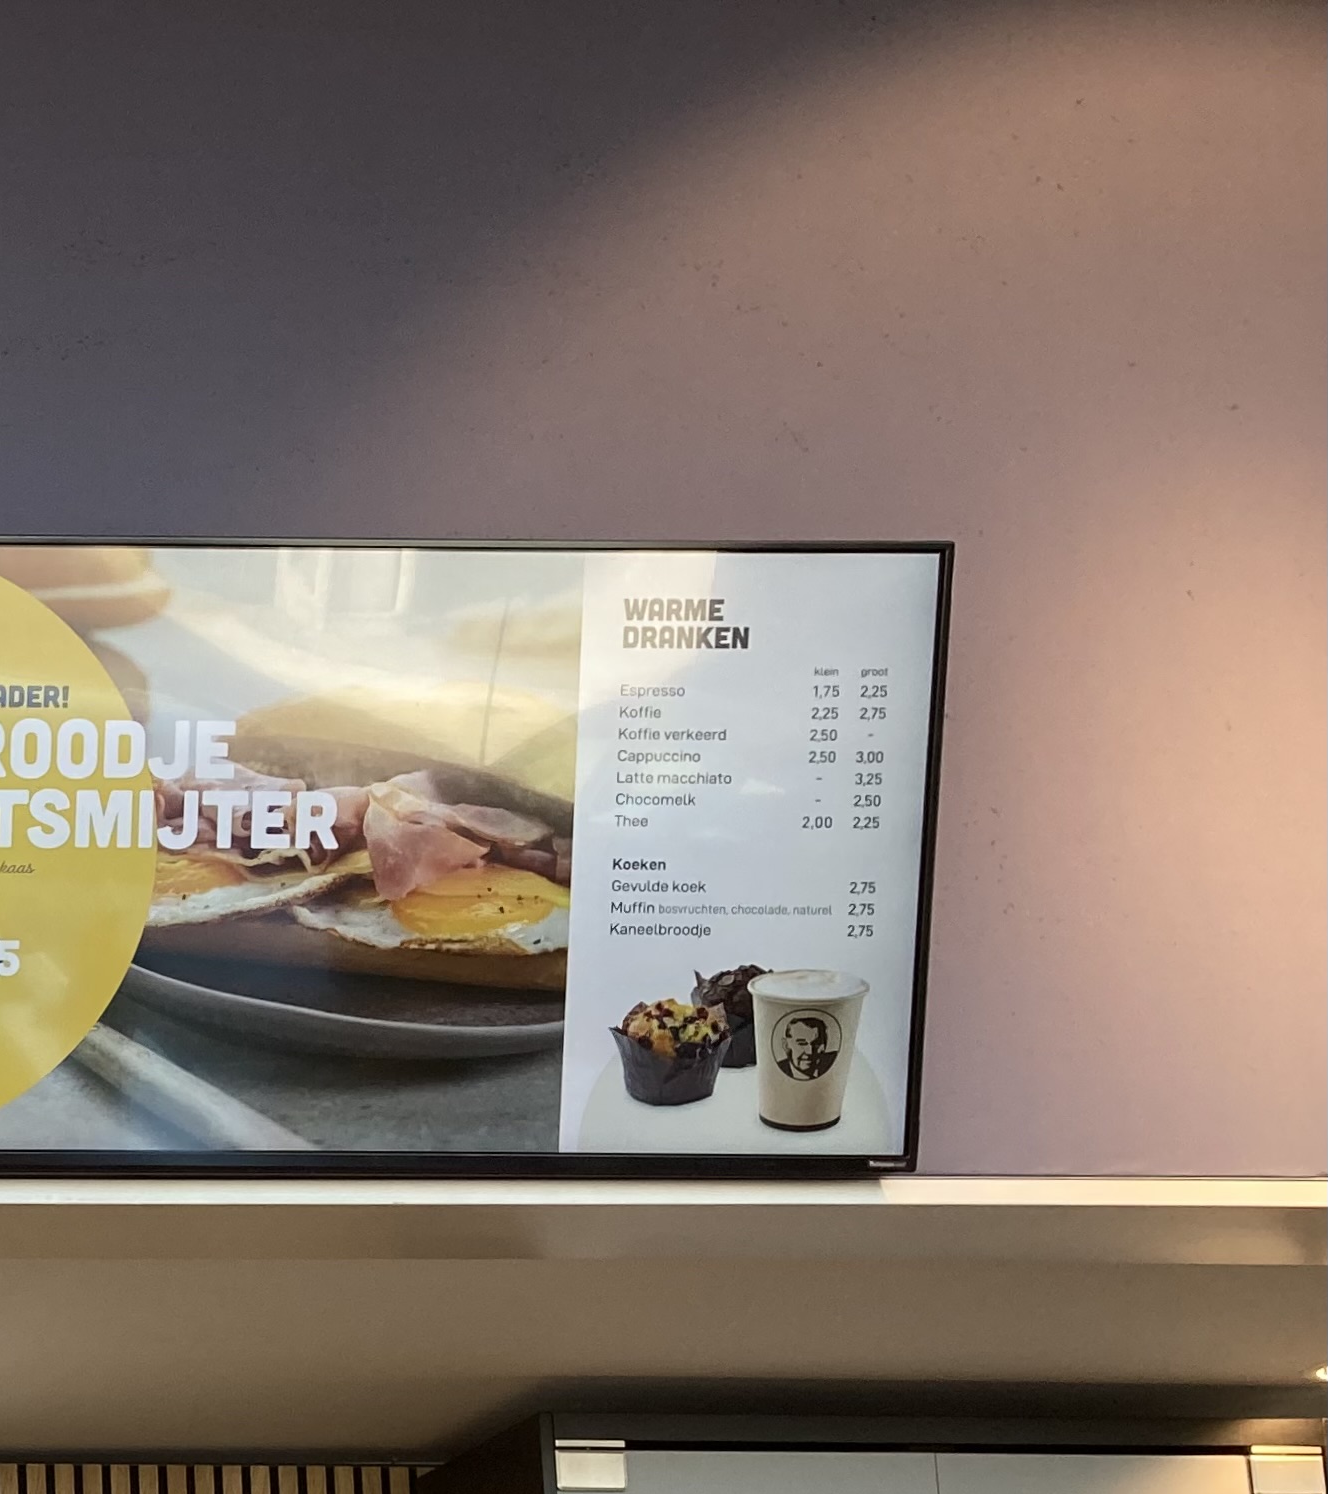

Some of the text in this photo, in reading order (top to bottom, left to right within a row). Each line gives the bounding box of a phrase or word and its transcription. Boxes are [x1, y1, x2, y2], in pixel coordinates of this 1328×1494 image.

[624, 598, 725, 622] WARME
[623, 626, 749, 649] DRANKEN
[613, 858, 666, 871] Koeken
[611, 880, 876, 896] Gevulde koek 2,75
[609, 923, 873, 939] Kaneelbroodje 2,75
